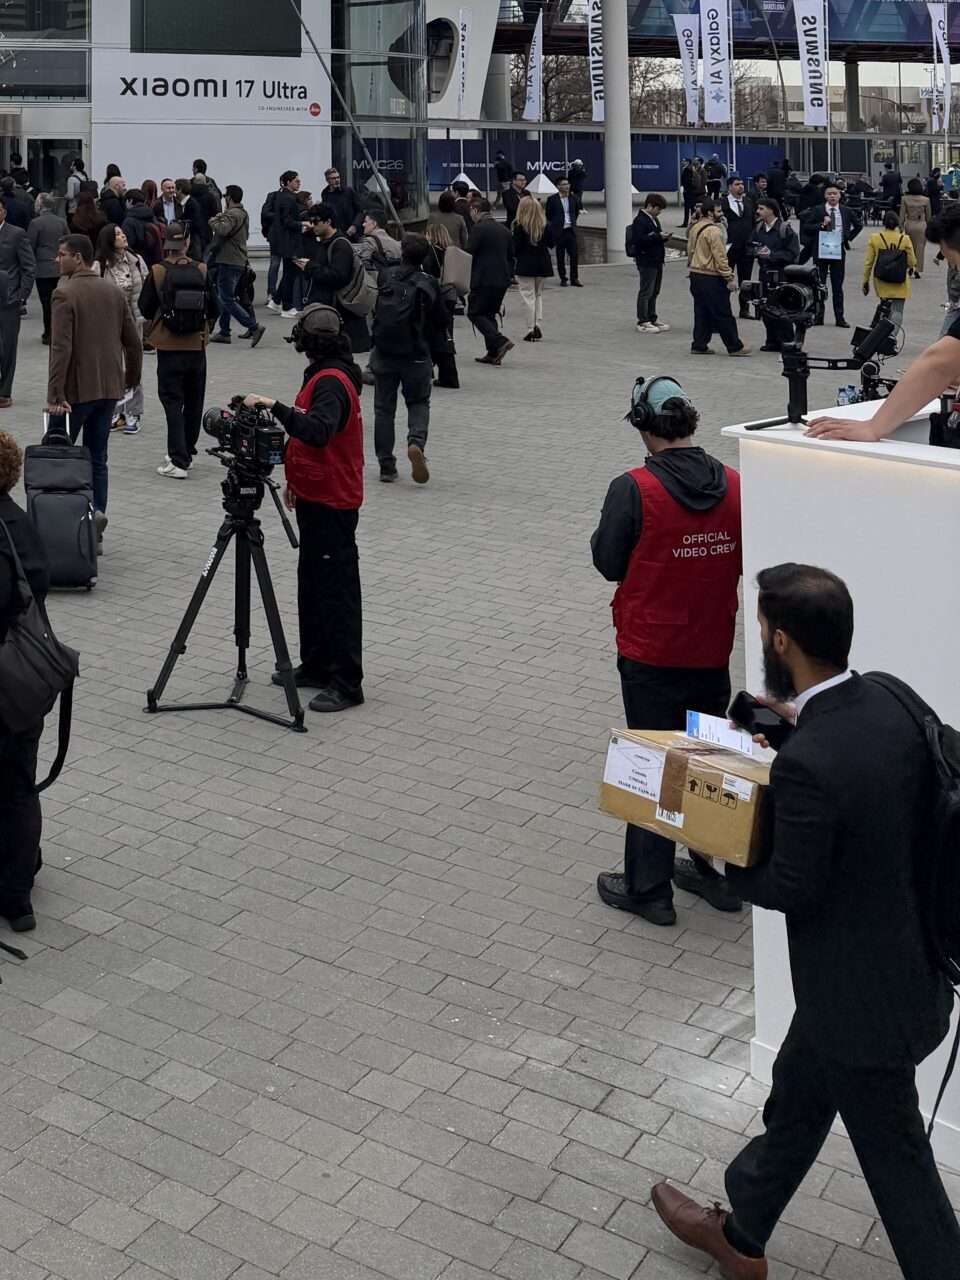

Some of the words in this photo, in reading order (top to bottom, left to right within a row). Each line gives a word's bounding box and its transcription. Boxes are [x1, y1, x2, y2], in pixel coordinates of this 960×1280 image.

[235, 80, 255, 98] 17
[263, 80, 307, 99] Ultra
[682, 531, 731, 545] OFFICIAL
[672, 547, 707, 558] VIDEO
[710, 541, 737, 555] CREW
